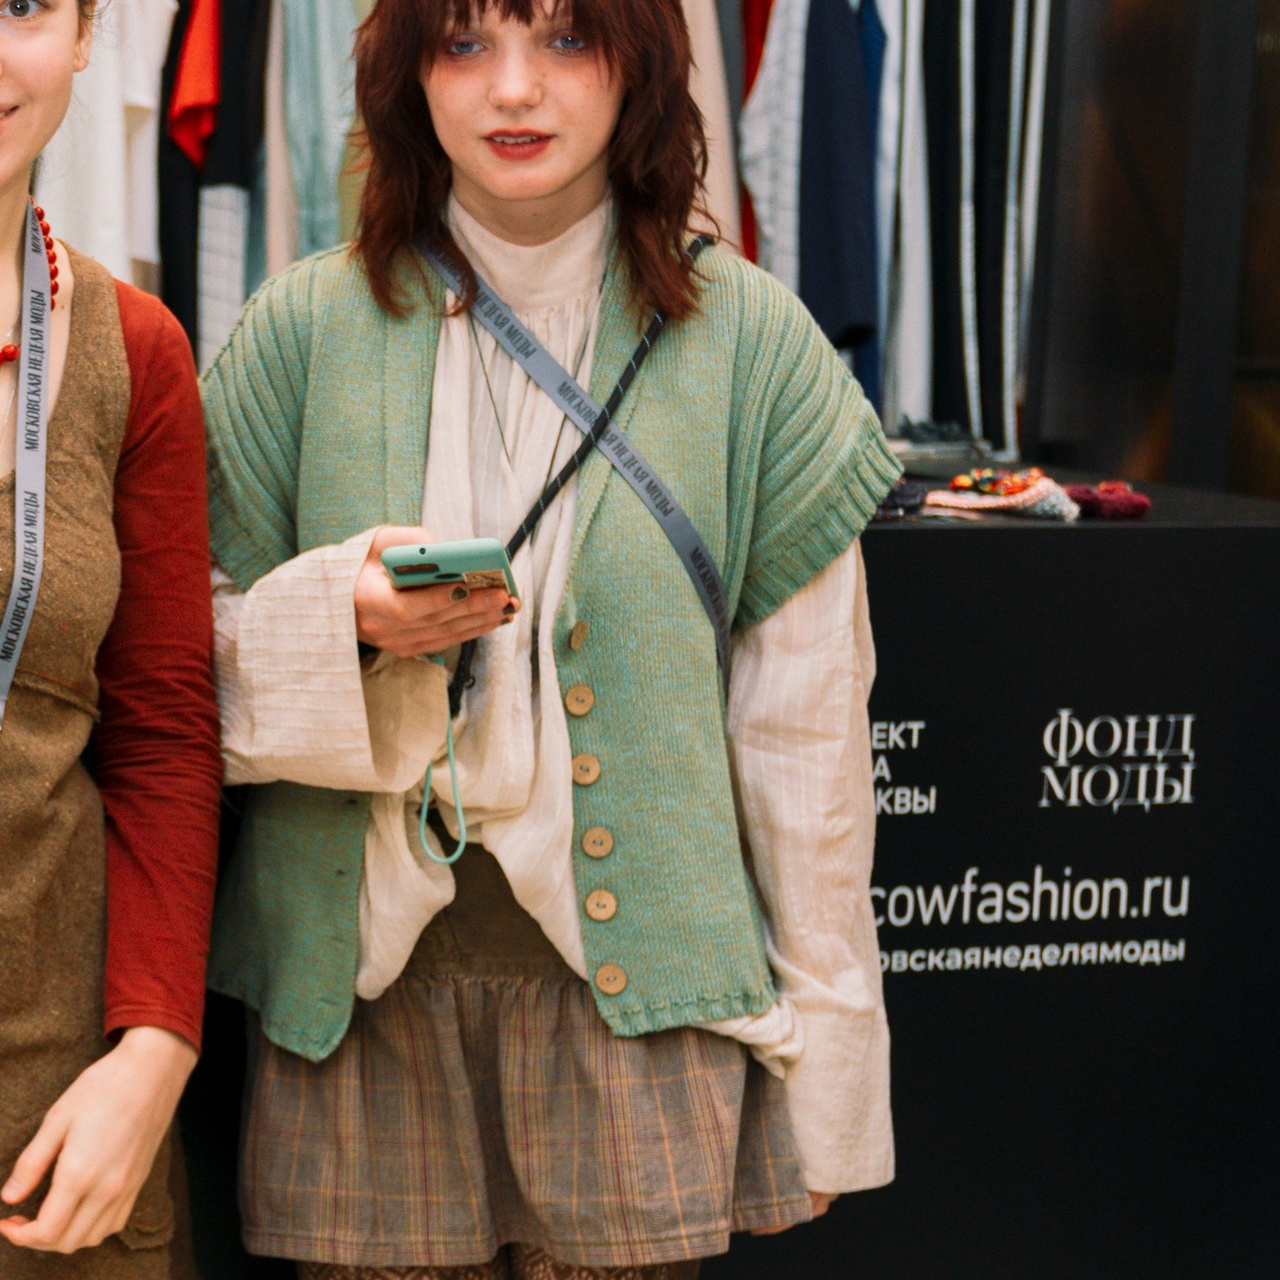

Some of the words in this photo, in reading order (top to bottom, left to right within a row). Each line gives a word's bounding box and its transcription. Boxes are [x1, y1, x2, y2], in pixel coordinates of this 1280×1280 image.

[31, 289, 46, 327] МОДЫ
[474, 290, 510, 330] НЕДЕЛЯ
[505, 323, 538, 360] МОДЫ
[27, 327, 46, 373] НЕДЕЛЯ
[24, 372, 42, 453] МОСКОВСКАЯ
[612, 444, 648, 483] НЕДЕЛЯ
[644, 478, 676, 518] МОДЫ
[23, 490, 39, 531] МОДЫ
[22, 529, 40, 577] НЕДЕЛЯ
[0, 576, 35, 663] МОСКОВСКАЯ
[871, 720, 927, 750] ЕКТ
[1042, 708, 1197, 767] ФОНД
[875, 786, 937, 816] КВЫ
[1038, 762, 1197, 814] МОДЫ
[869, 865, 1190, 927] cowfashion.ru
[879, 938, 1187, 973] овскаянеделямоды
